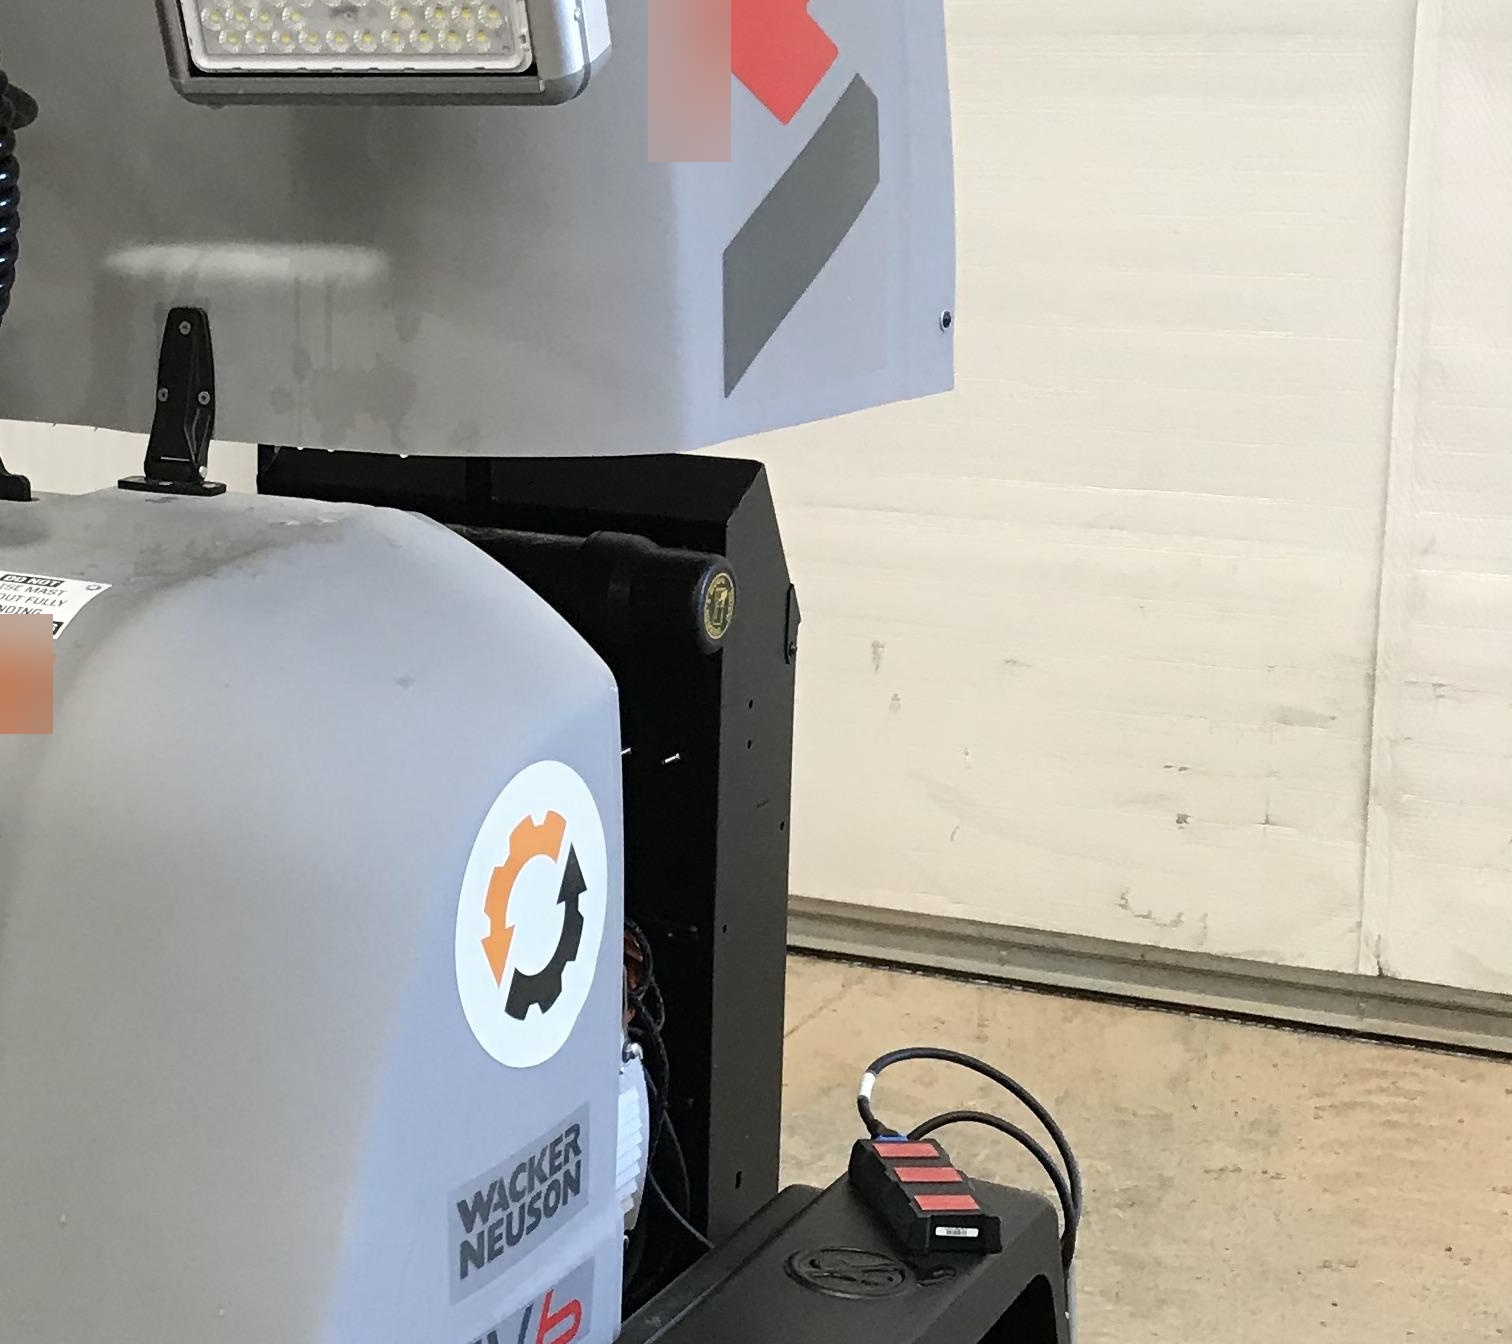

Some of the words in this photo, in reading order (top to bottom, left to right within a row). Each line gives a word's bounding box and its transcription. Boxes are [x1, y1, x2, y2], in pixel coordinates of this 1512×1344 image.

[1, 575, 26, 584] DO
[25, 578, 63, 587] NOT
[24, 585, 68, 597] MAST
[28, 595, 68, 607] FULLY
[456, 1122, 583, 1234] WACKER
[458, 1159, 582, 1281] NEUSON
